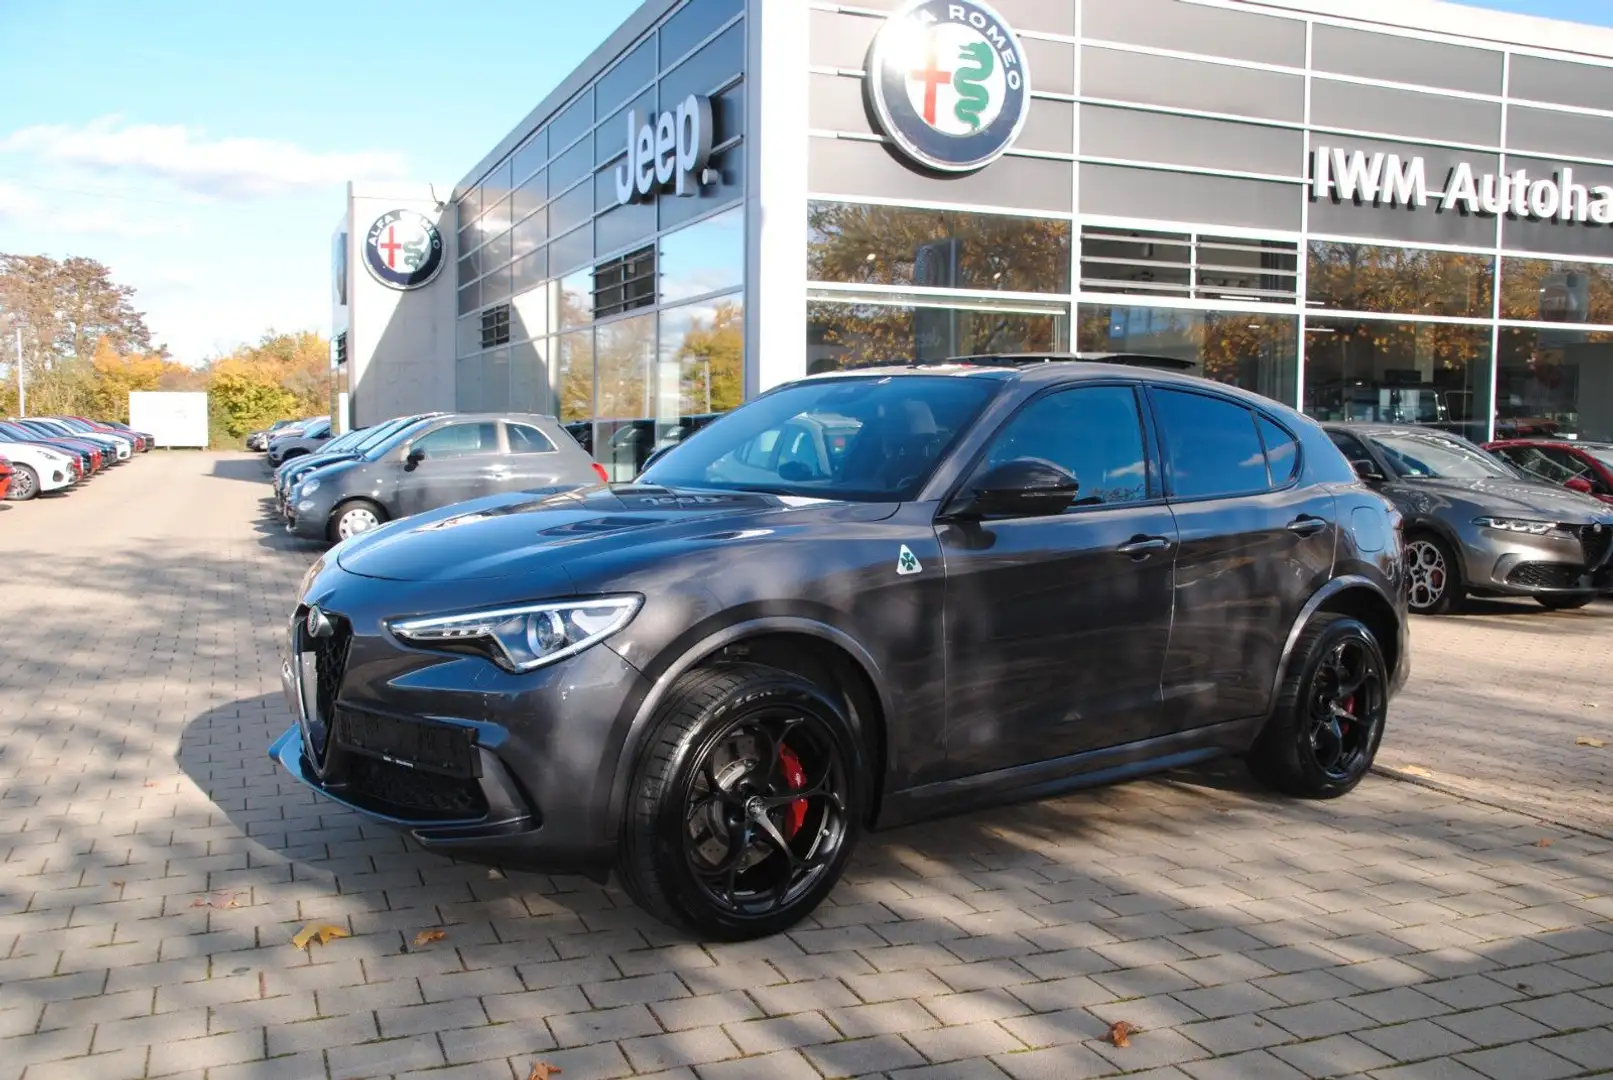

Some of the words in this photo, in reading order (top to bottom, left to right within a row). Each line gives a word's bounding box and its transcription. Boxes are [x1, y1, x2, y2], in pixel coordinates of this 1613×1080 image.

[949, 4, 1021, 91] ROMEO
[1315, 146, 1427, 206] IWM
[368, 213, 395, 247] ALFA
